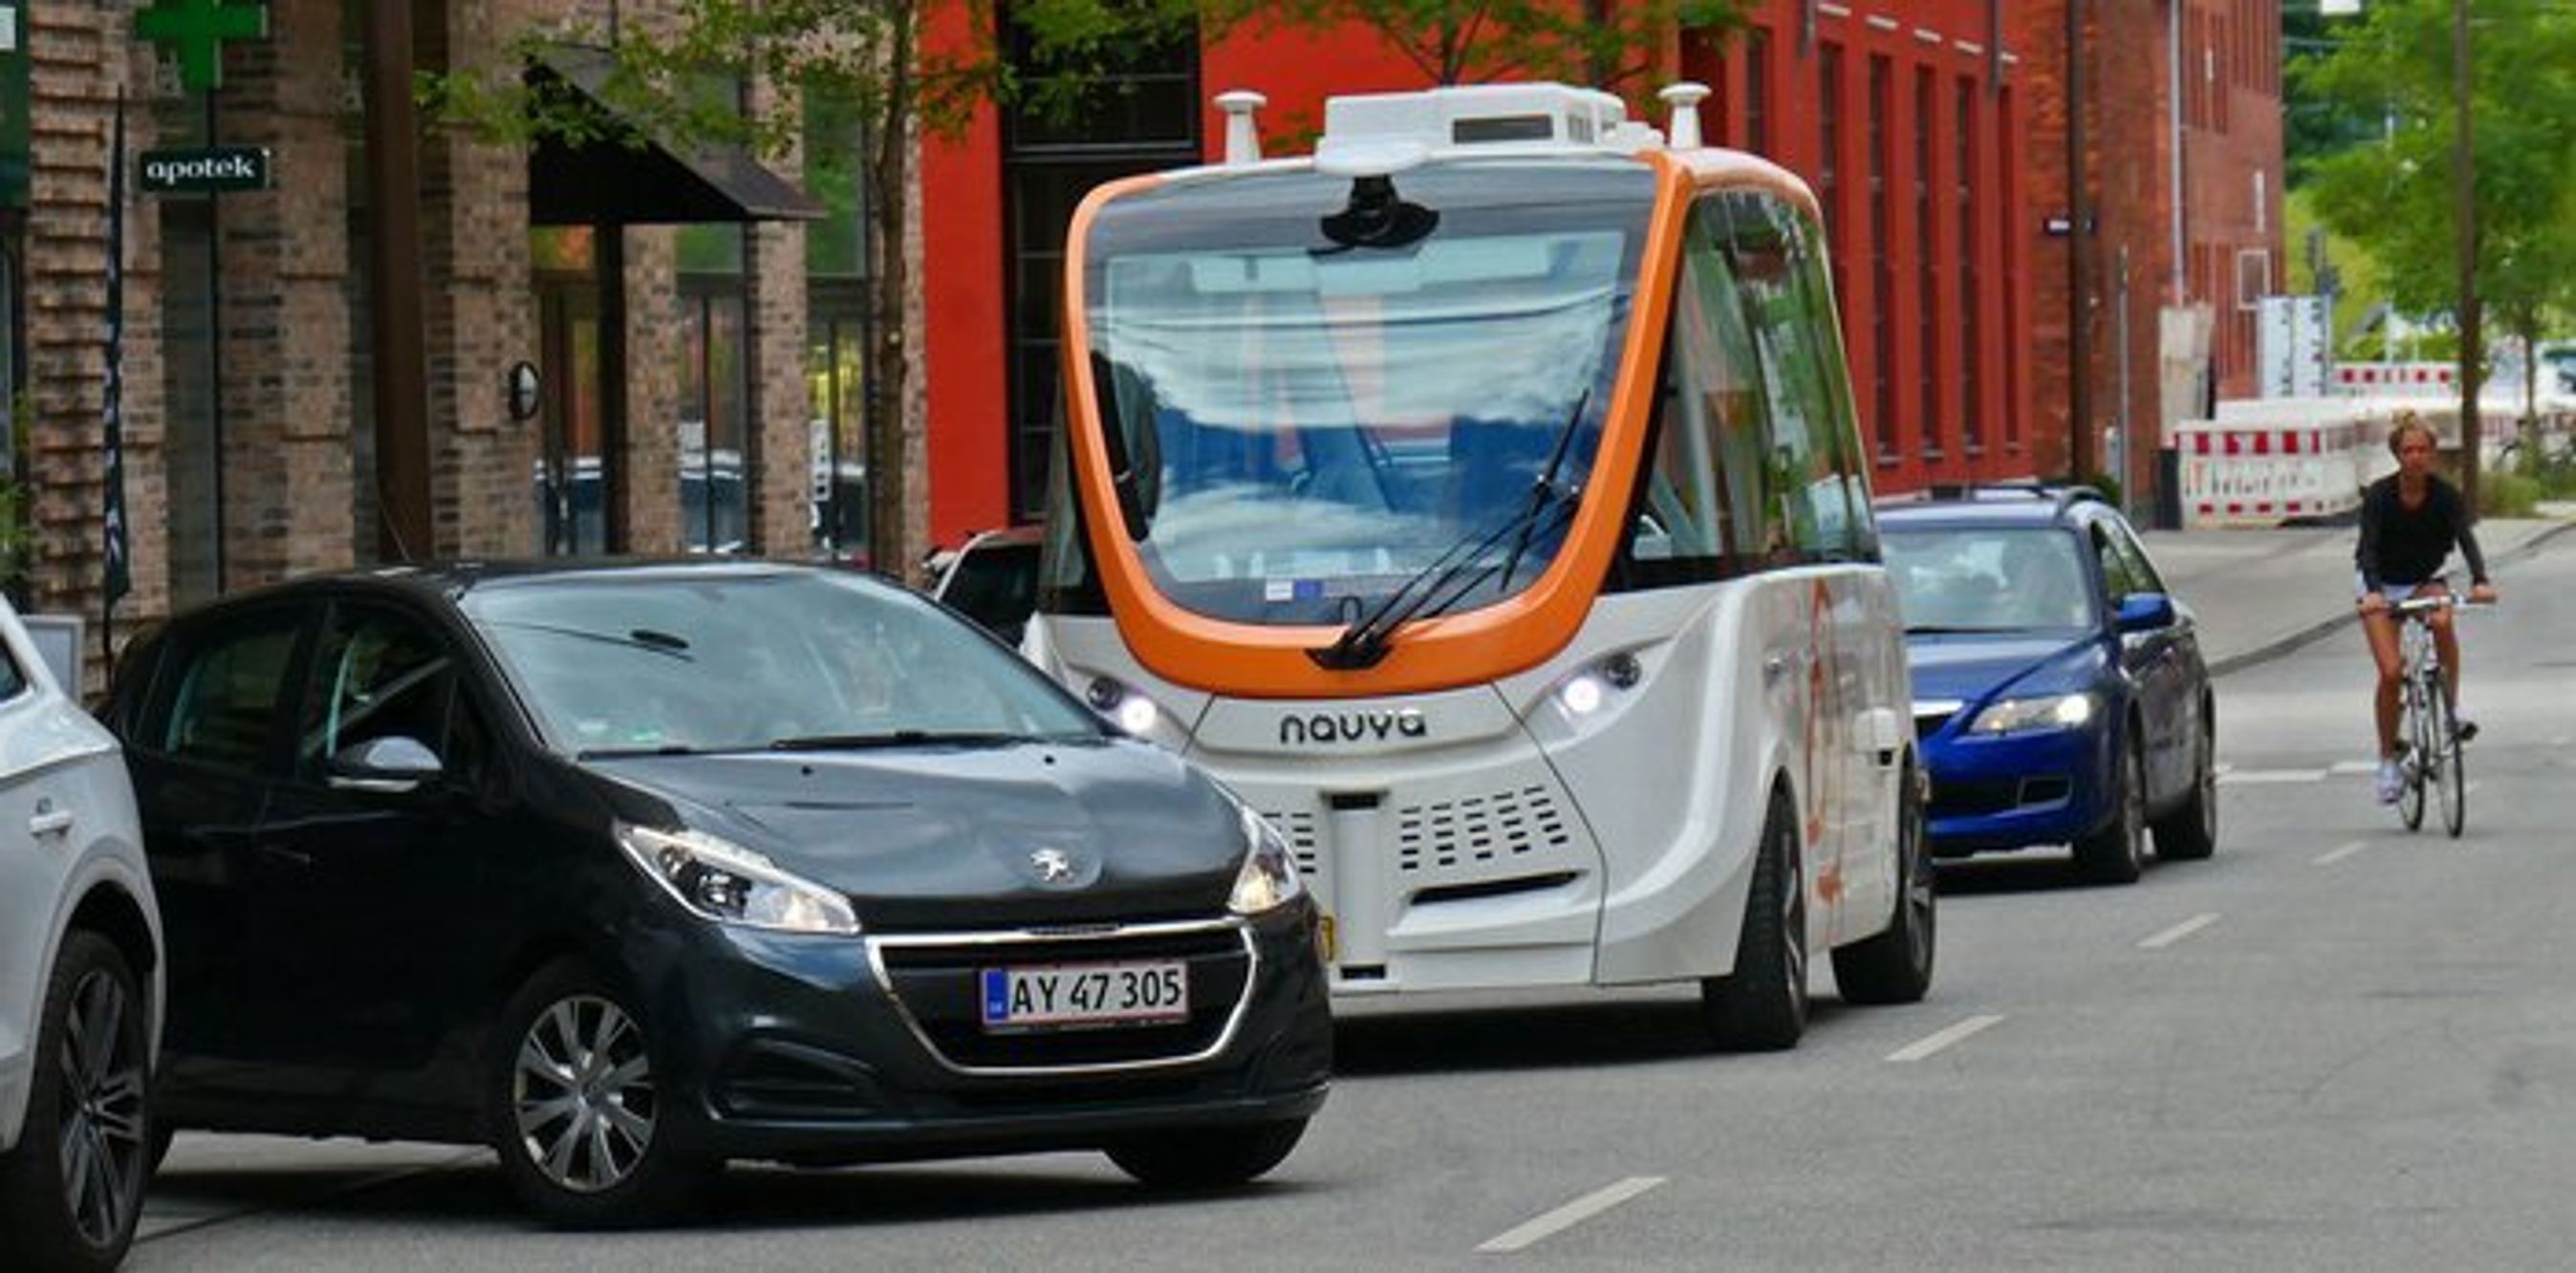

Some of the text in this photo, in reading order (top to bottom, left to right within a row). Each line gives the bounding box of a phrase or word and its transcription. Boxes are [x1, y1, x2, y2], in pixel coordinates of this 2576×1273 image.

[146, 155, 255, 185] apotek
[1011, 968, 1181, 1013] AY 47 305
